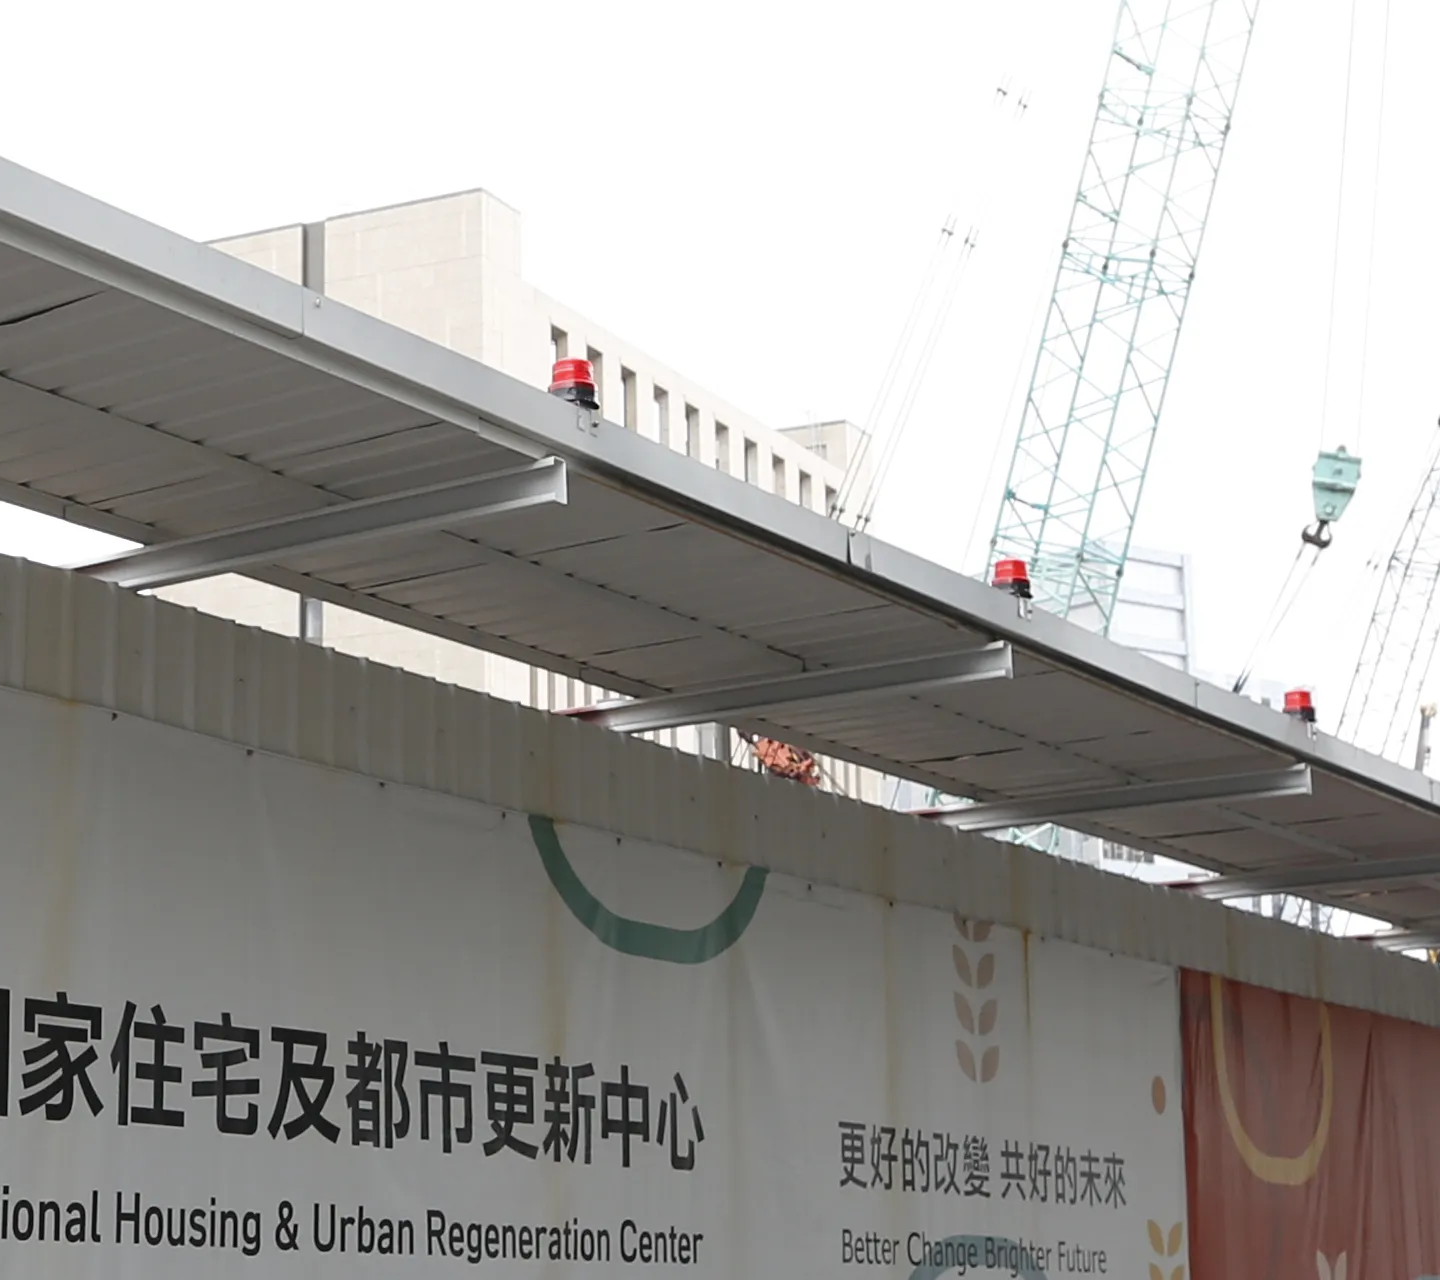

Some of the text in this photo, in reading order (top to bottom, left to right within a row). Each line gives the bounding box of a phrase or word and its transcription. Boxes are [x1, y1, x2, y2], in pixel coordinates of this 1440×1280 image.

[838, 1121, 1126, 1209] 更好的改變 共好的未來
[115, 1191, 261, 1257] Housing
[275, 1200, 300, 1251] &
[313, 1202, 415, 1255] Urban
[426, 1209, 611, 1264] Regeneration
[619, 1219, 704, 1266] Center
[842, 1228, 1107, 1279] Better Change Brighter Future
